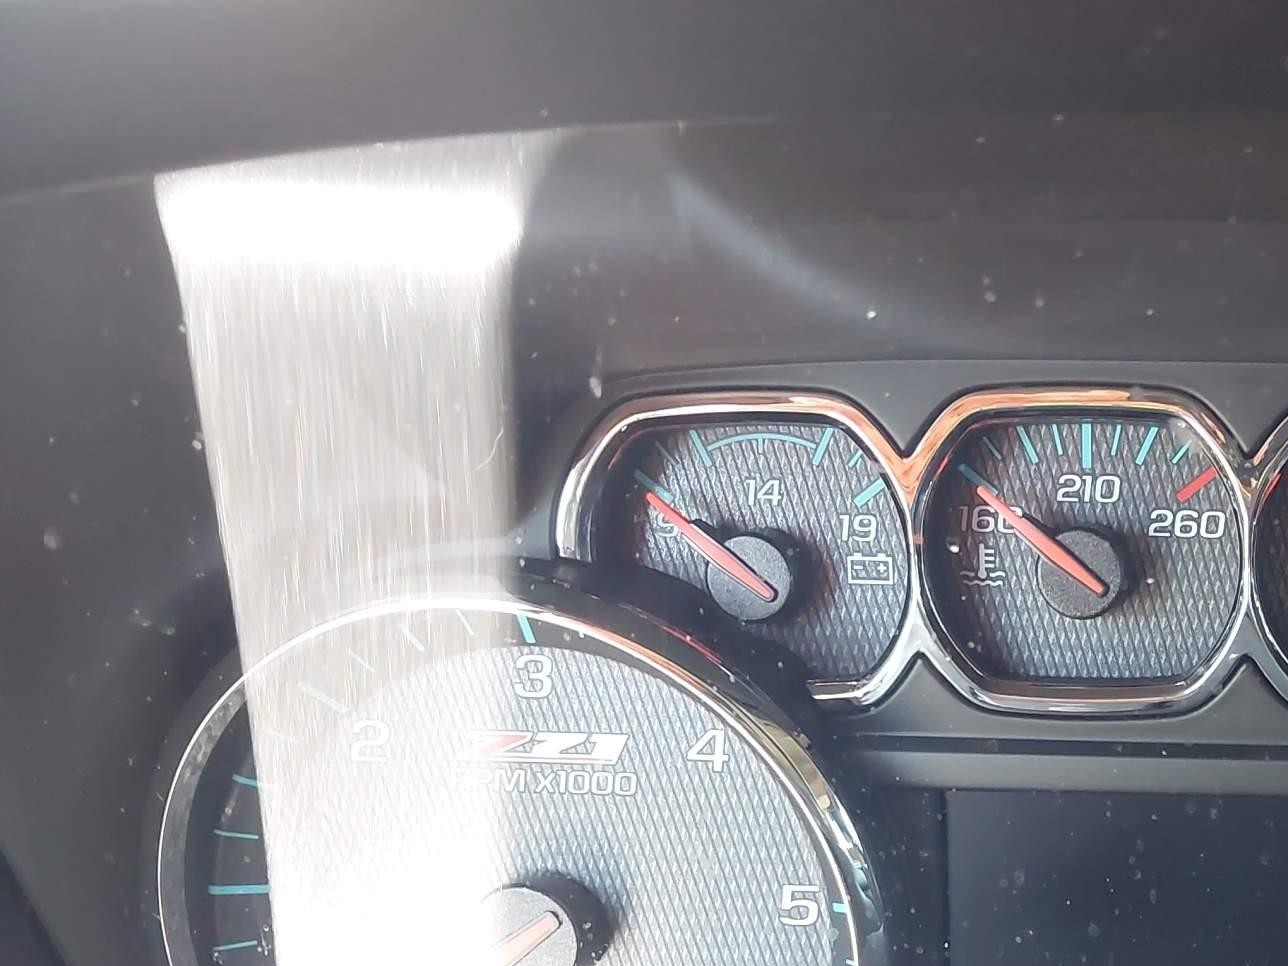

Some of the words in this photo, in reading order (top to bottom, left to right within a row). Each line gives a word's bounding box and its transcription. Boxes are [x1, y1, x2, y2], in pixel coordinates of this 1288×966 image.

[747, 478, 783, 505] 14
[1057, 474, 1120, 504] 210
[840, 514, 877, 542] 19
[1149, 509, 1225, 539] 260
[514, 655, 553, 699] 3
[350, 721, 390, 764] 2
[687, 729, 729, 772] 4
[779, 885, 819, 926] 5
